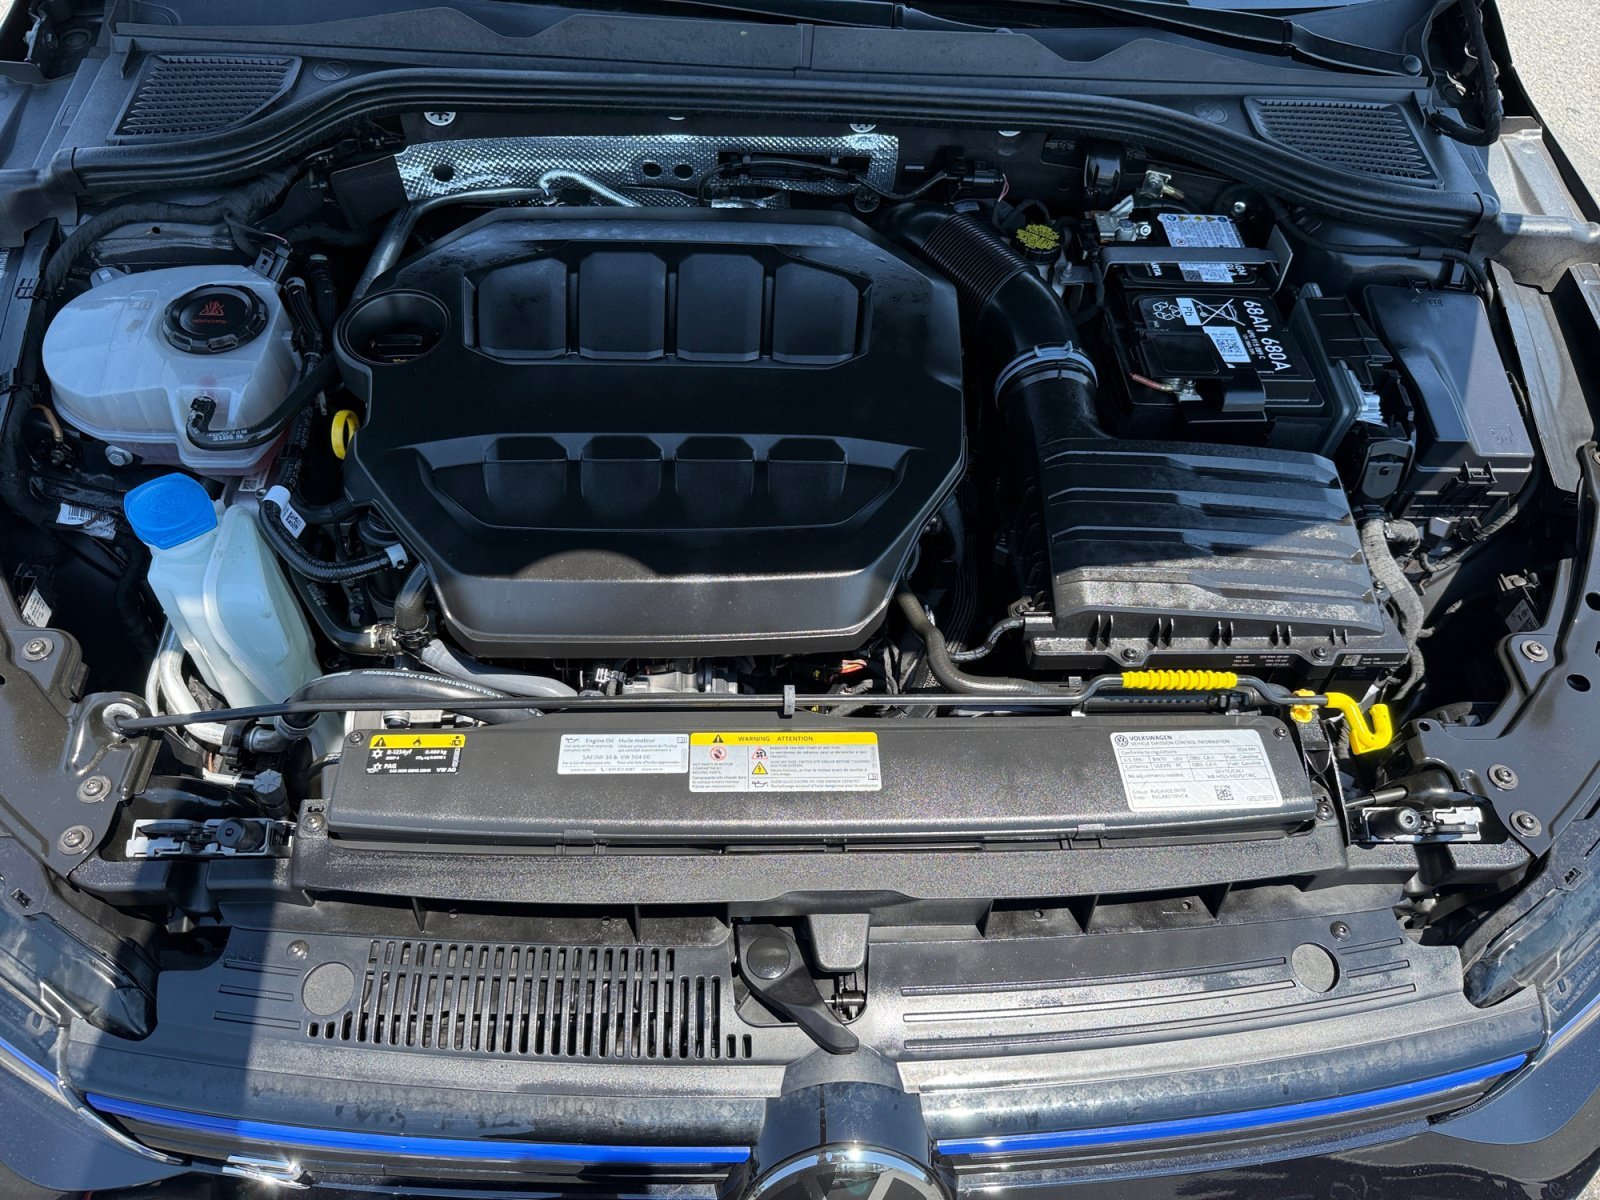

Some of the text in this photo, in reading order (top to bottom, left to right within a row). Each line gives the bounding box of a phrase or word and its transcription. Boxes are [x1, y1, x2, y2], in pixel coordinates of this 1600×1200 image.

[1182, 306, 1194, 317] Pb
[1243, 300, 1272, 332] 68Ah
[1260, 338, 1292, 371] 680A
